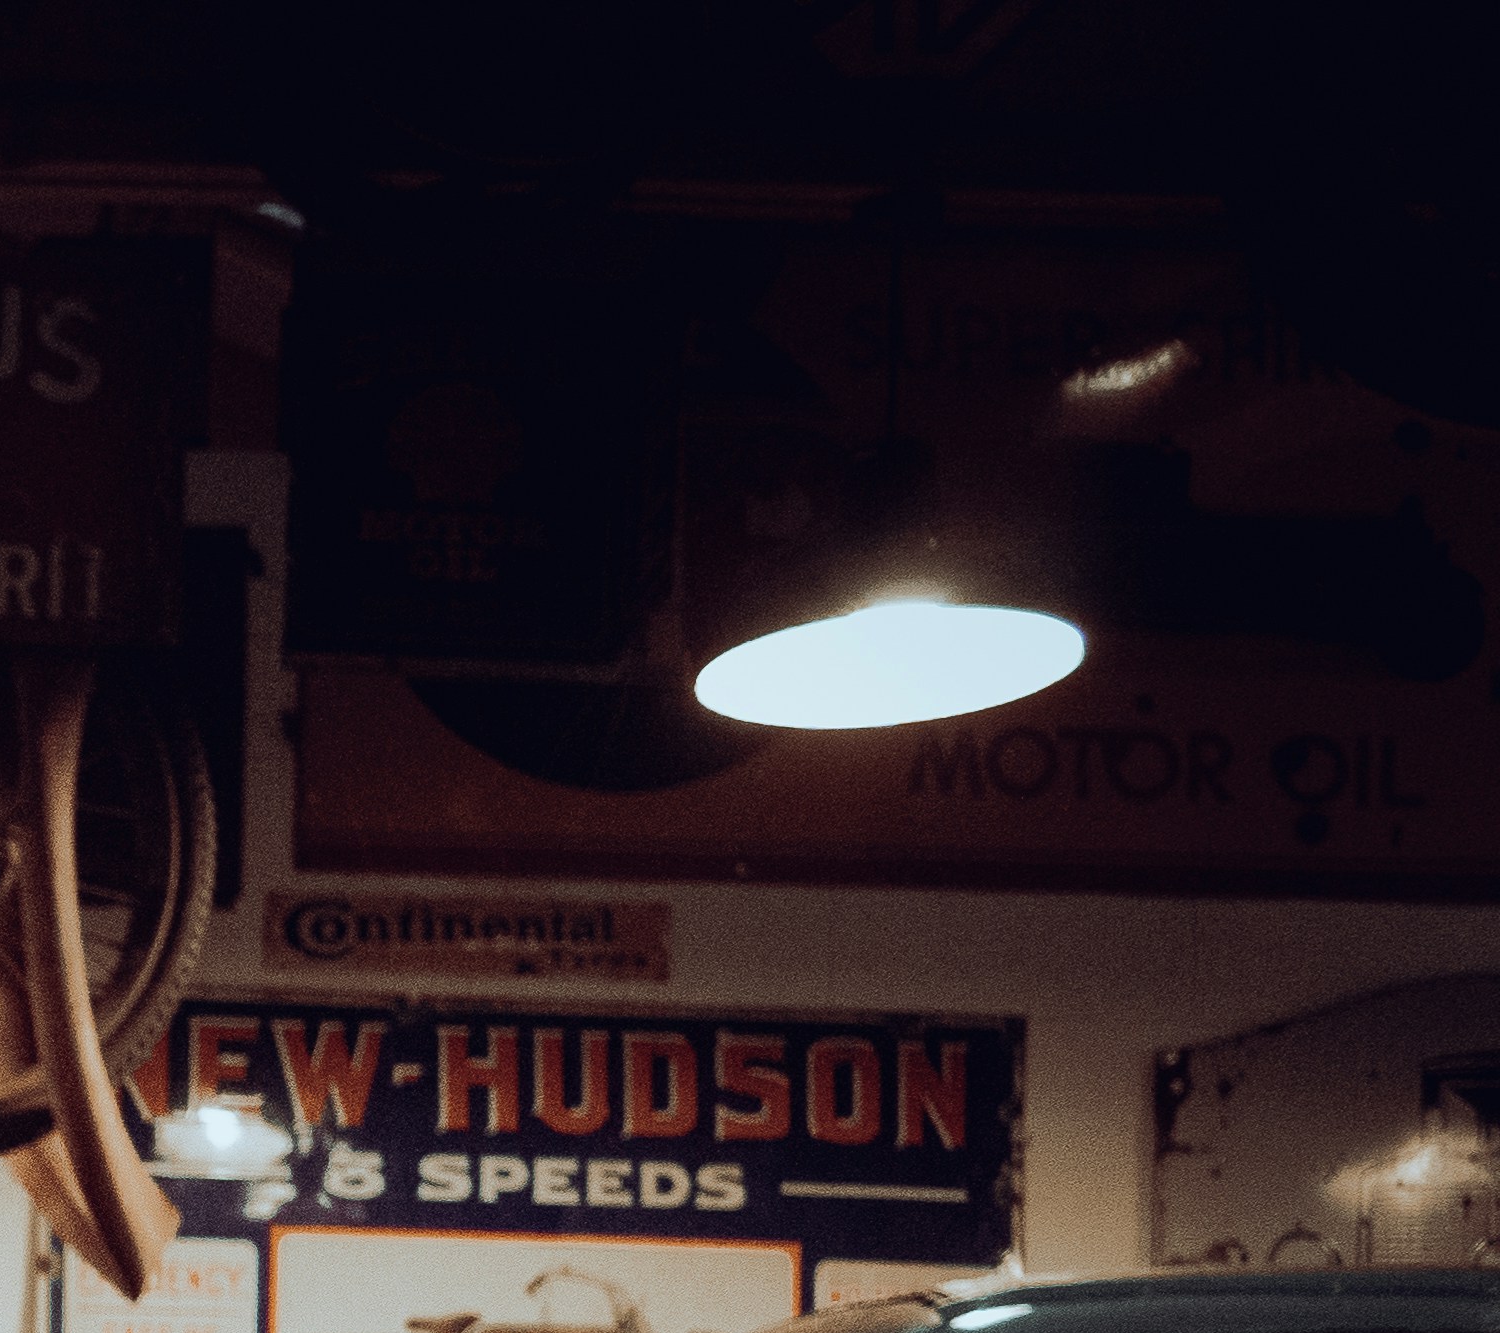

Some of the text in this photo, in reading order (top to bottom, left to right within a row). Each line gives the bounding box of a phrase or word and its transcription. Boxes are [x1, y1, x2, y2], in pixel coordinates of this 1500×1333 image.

[917, 722, 1426, 811] MOTOR OIL
[285, 900, 616, 960] Continental
[415, 1150, 749, 1212] SPEEDS
